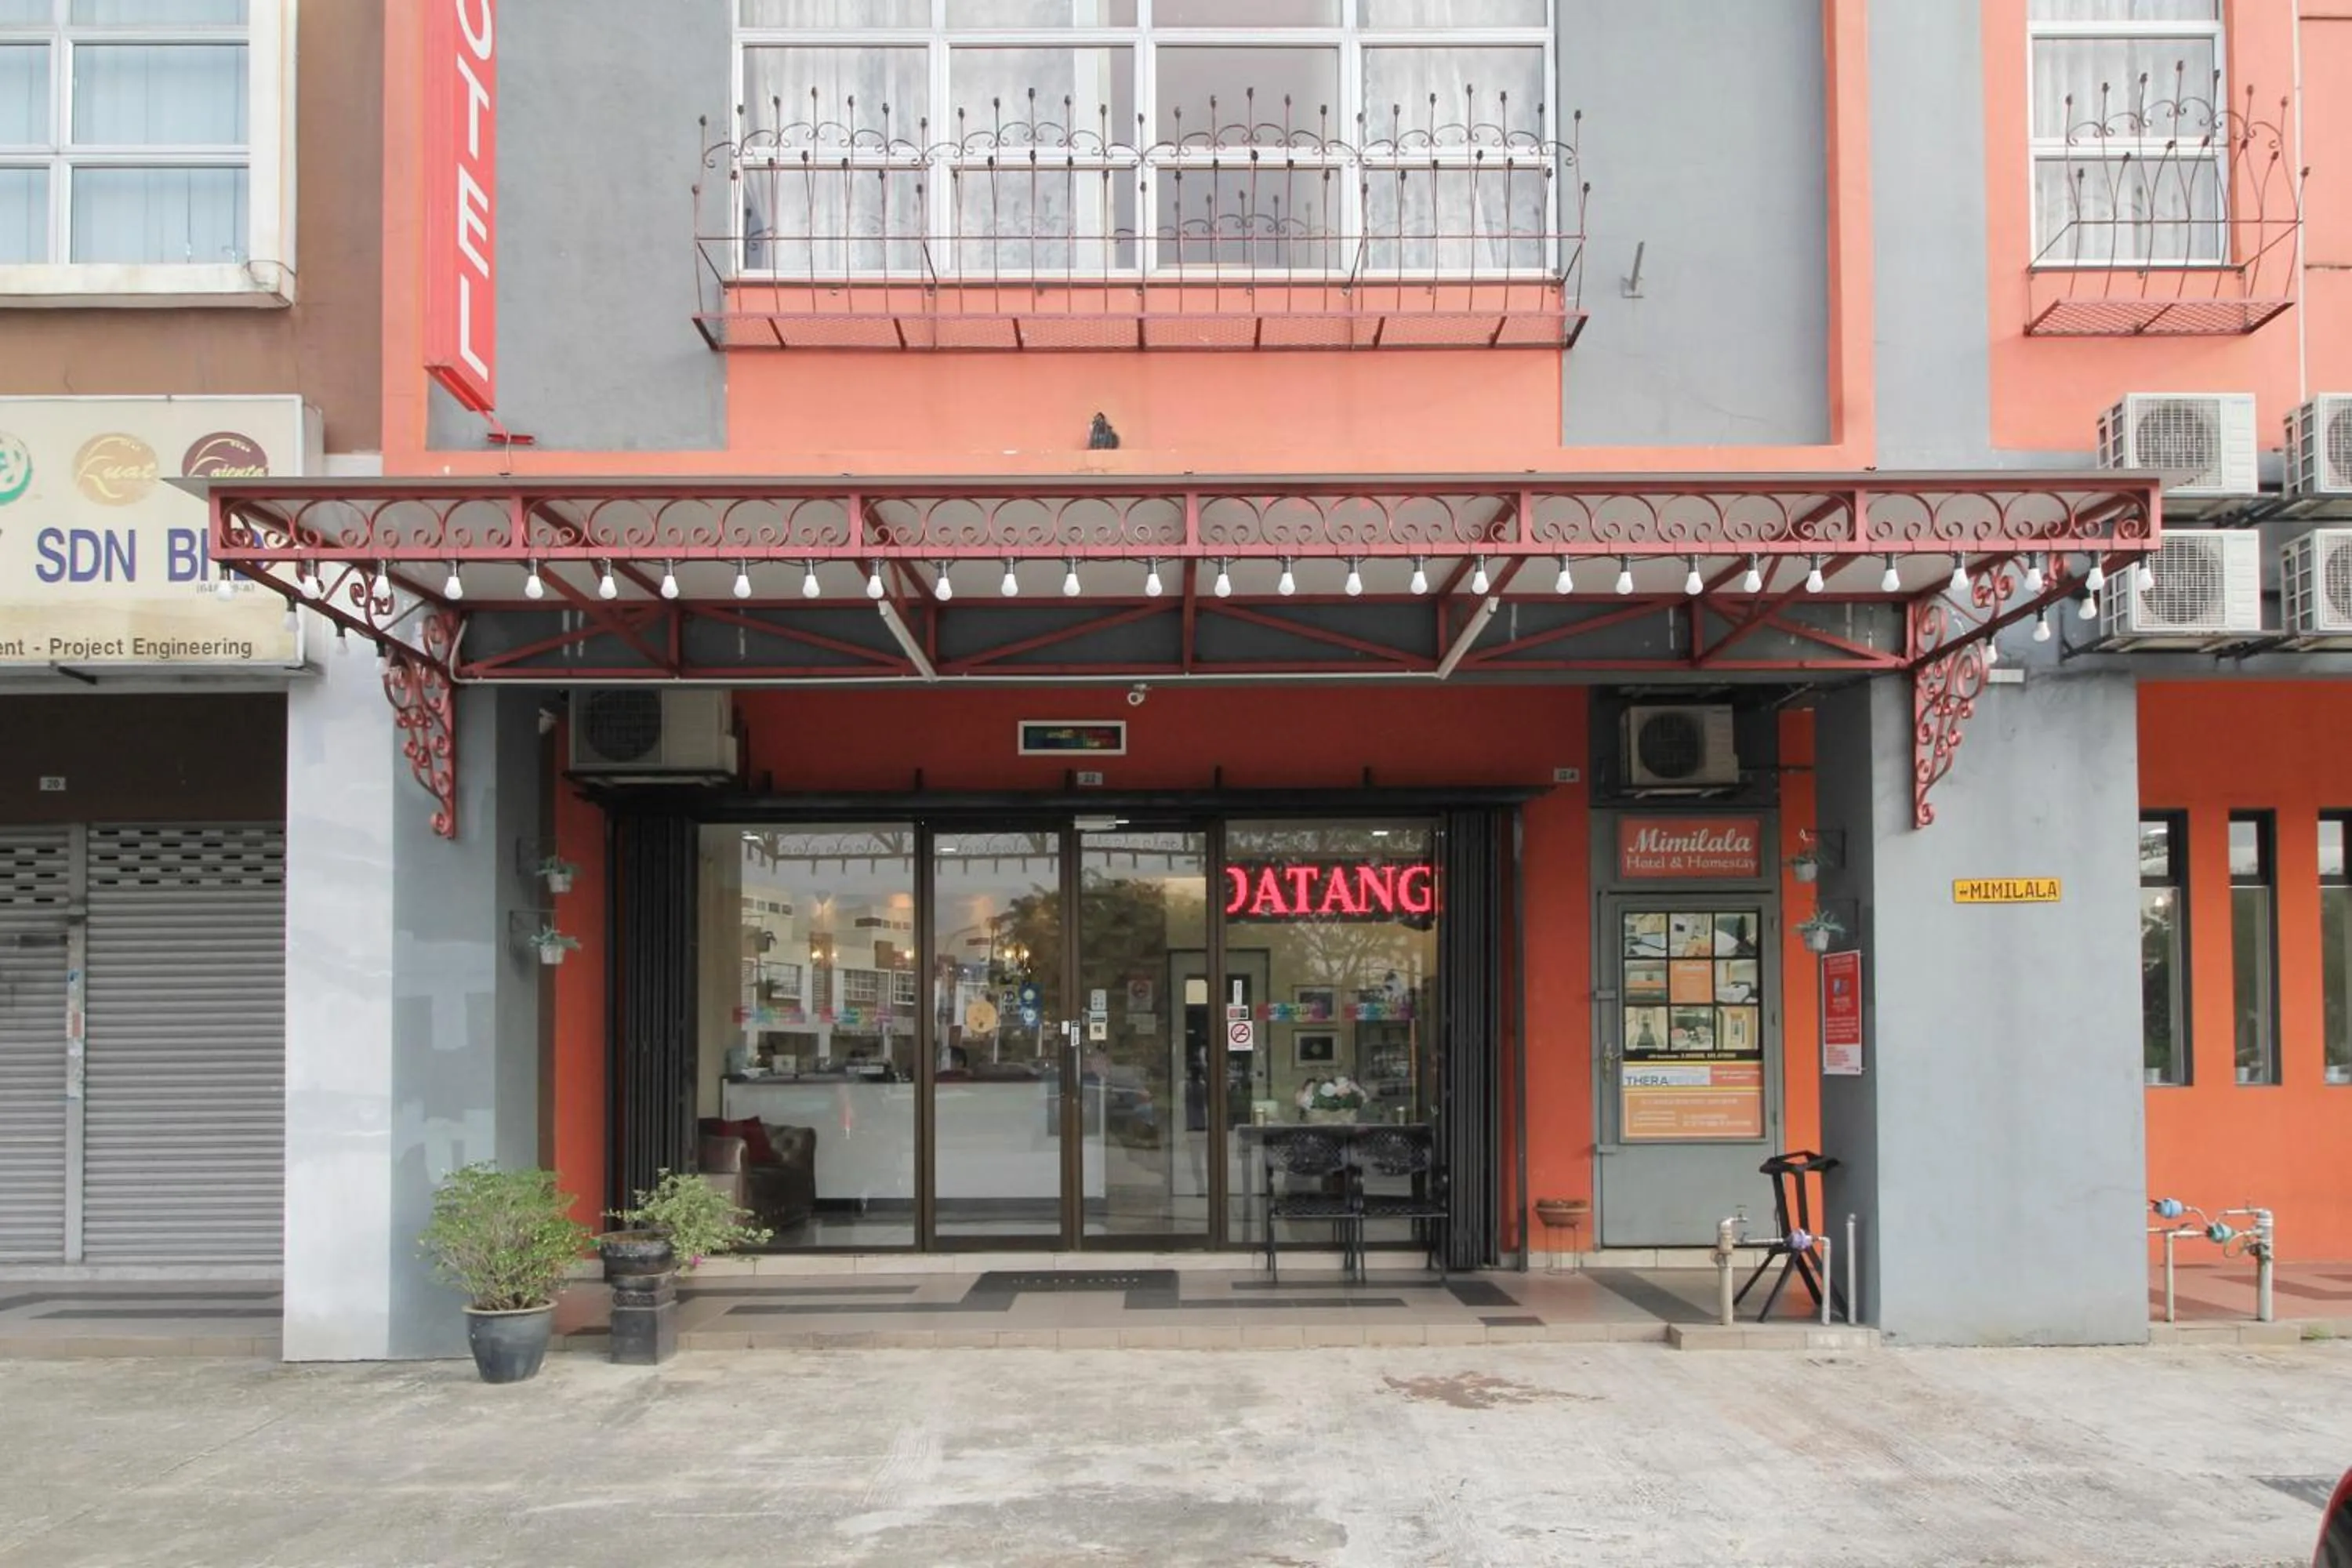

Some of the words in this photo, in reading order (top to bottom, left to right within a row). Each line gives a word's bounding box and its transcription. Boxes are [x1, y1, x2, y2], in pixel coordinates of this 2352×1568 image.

[36, 527, 136, 583] SDN
[49, 637, 124, 659] Project
[133, 637, 252, 659] Engineering
[1628, 828, 1753, 853] Mimilala
[1626, 855, 1665, 869] Hotel
[1670, 855, 1683, 869] &
[1688, 855, 1758, 870] Homestay
